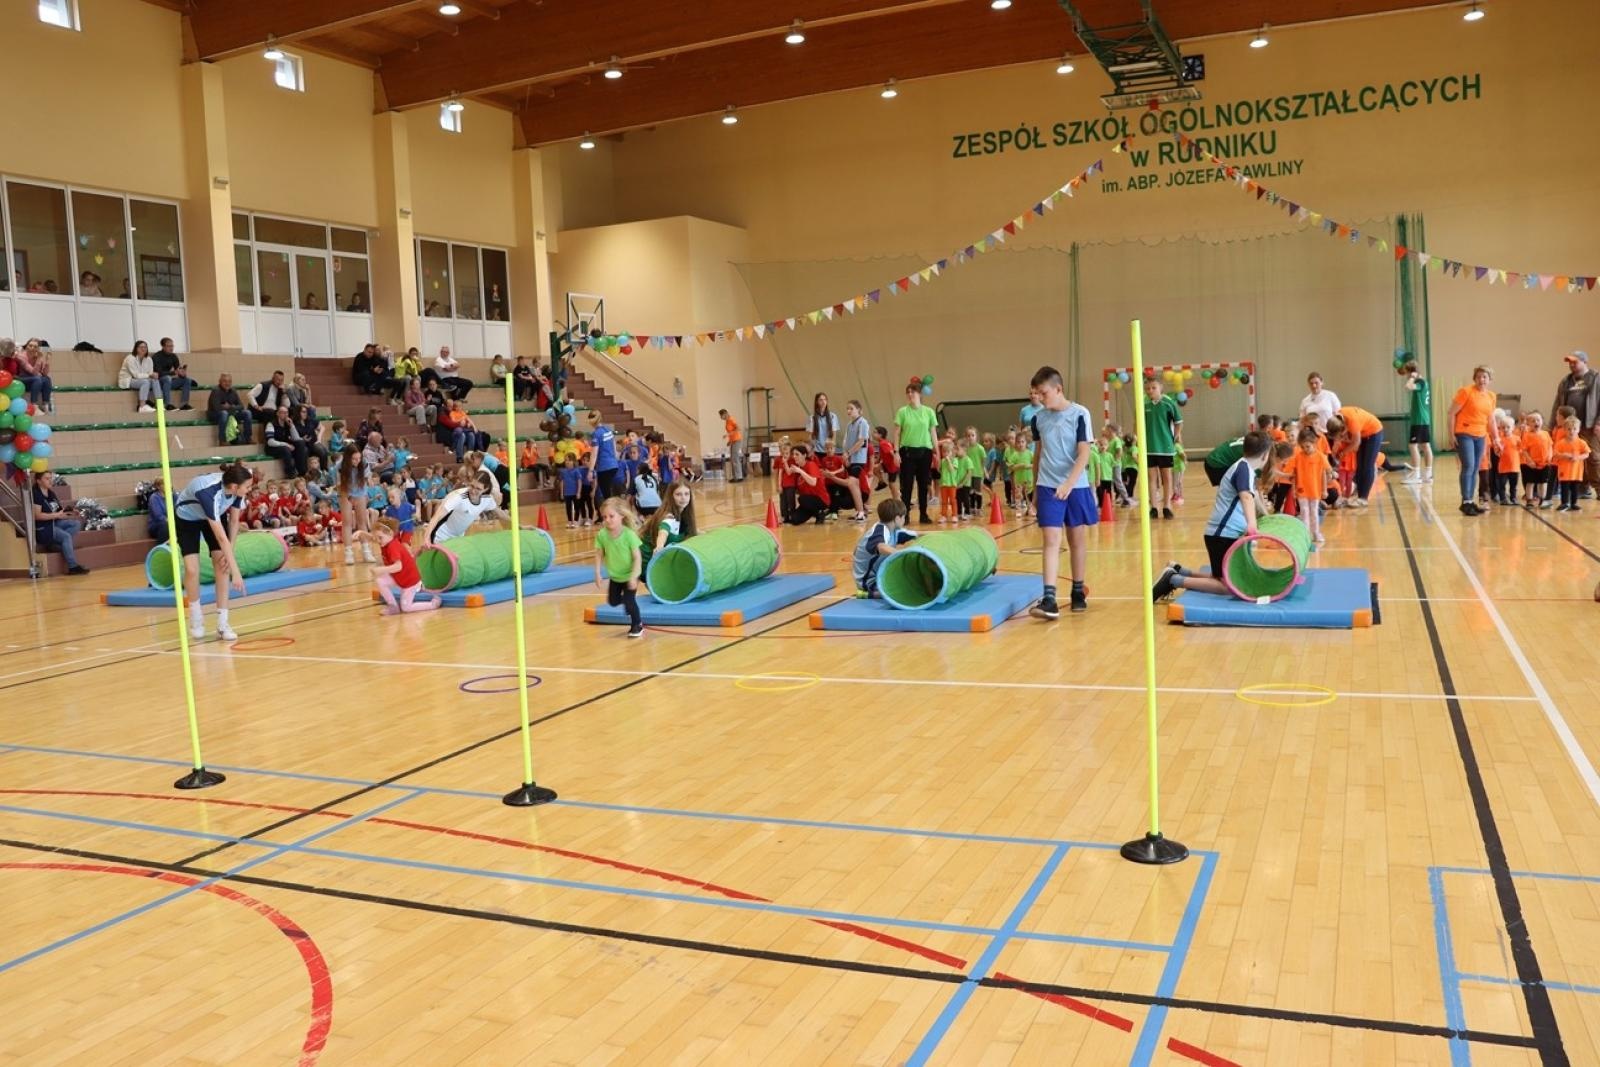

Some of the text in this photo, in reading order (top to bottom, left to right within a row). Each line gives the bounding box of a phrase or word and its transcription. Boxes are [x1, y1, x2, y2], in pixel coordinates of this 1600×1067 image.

[952, 73, 1481, 158] ZESPÓŁ SZKÓŁ OGÓLNOKSZTAŁCĄCYCH
[1158, 129, 1277, 166] RUDNIKU
[1102, 179, 1123, 193] im.
[1127, 174, 1161, 191] ABP.
[1166, 167, 1226, 187] JÓZEFA
